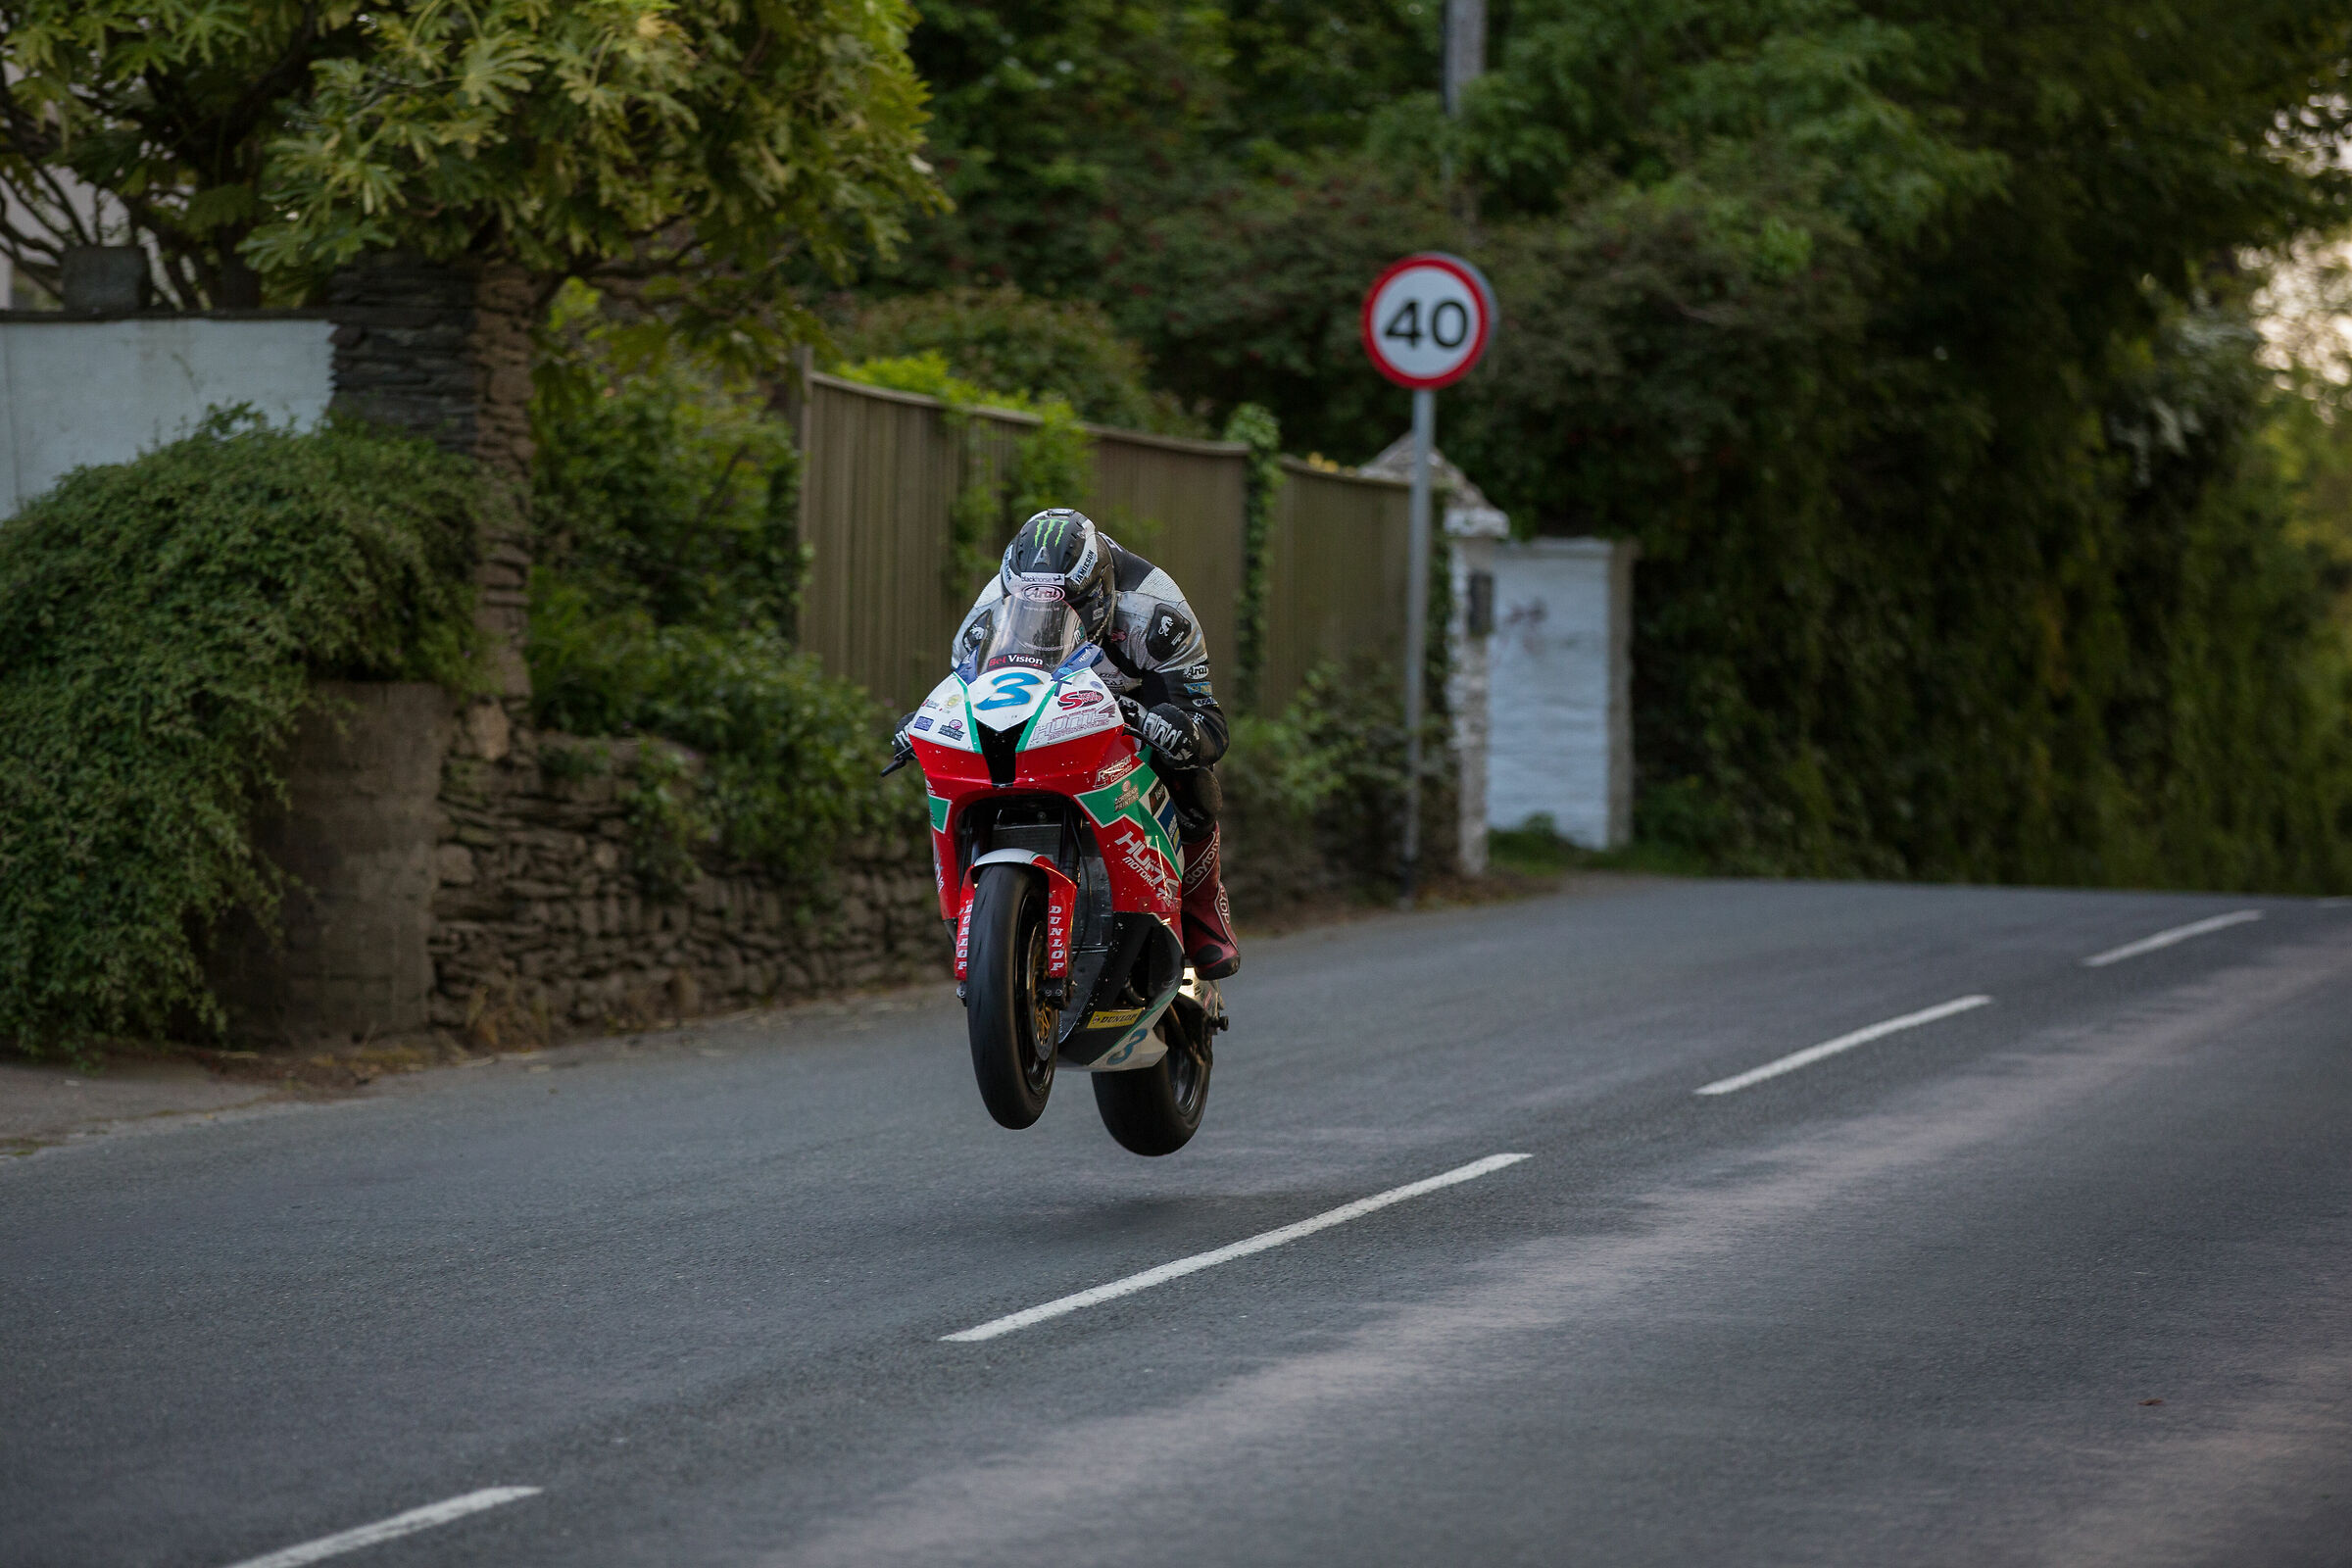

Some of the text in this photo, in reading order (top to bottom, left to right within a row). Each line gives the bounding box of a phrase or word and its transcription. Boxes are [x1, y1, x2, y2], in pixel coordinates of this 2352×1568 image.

[1385, 300, 1468, 349] 40
[1075, 550, 1095, 584] JAMIESON
[1025, 587, 1057, 599] Arai
[1007, 655, 1043, 665] Vision
[1185, 666, 1206, 678] Arai
[973, 671, 1044, 711] 3
[1050, 906, 1064, 971] DUNLOP
[1101, 1013, 1137, 1023] DUNLOP
